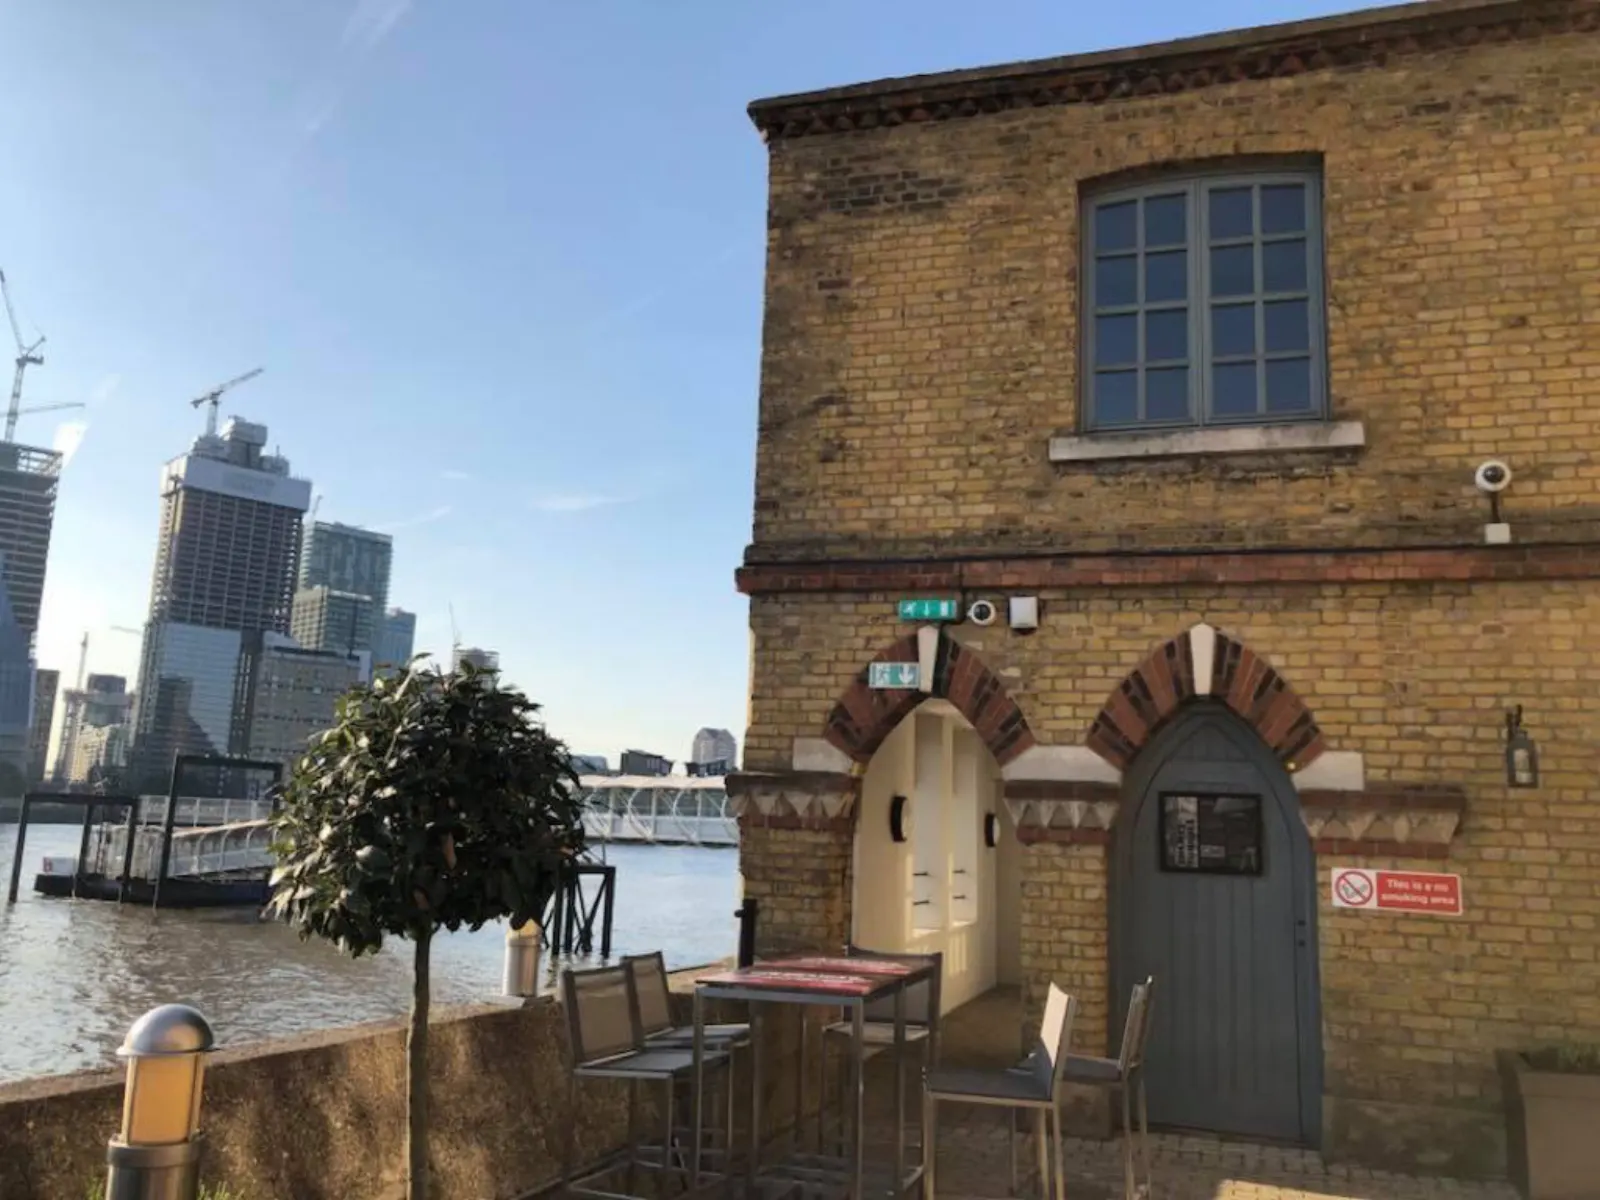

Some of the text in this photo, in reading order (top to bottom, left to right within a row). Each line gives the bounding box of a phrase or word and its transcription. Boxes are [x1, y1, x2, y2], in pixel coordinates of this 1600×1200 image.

[1387, 878, 1409, 890] This
[1412, 880, 1422, 891] is
[1433, 882, 1449, 892] no
[1380, 891, 1455, 905] smoking area
